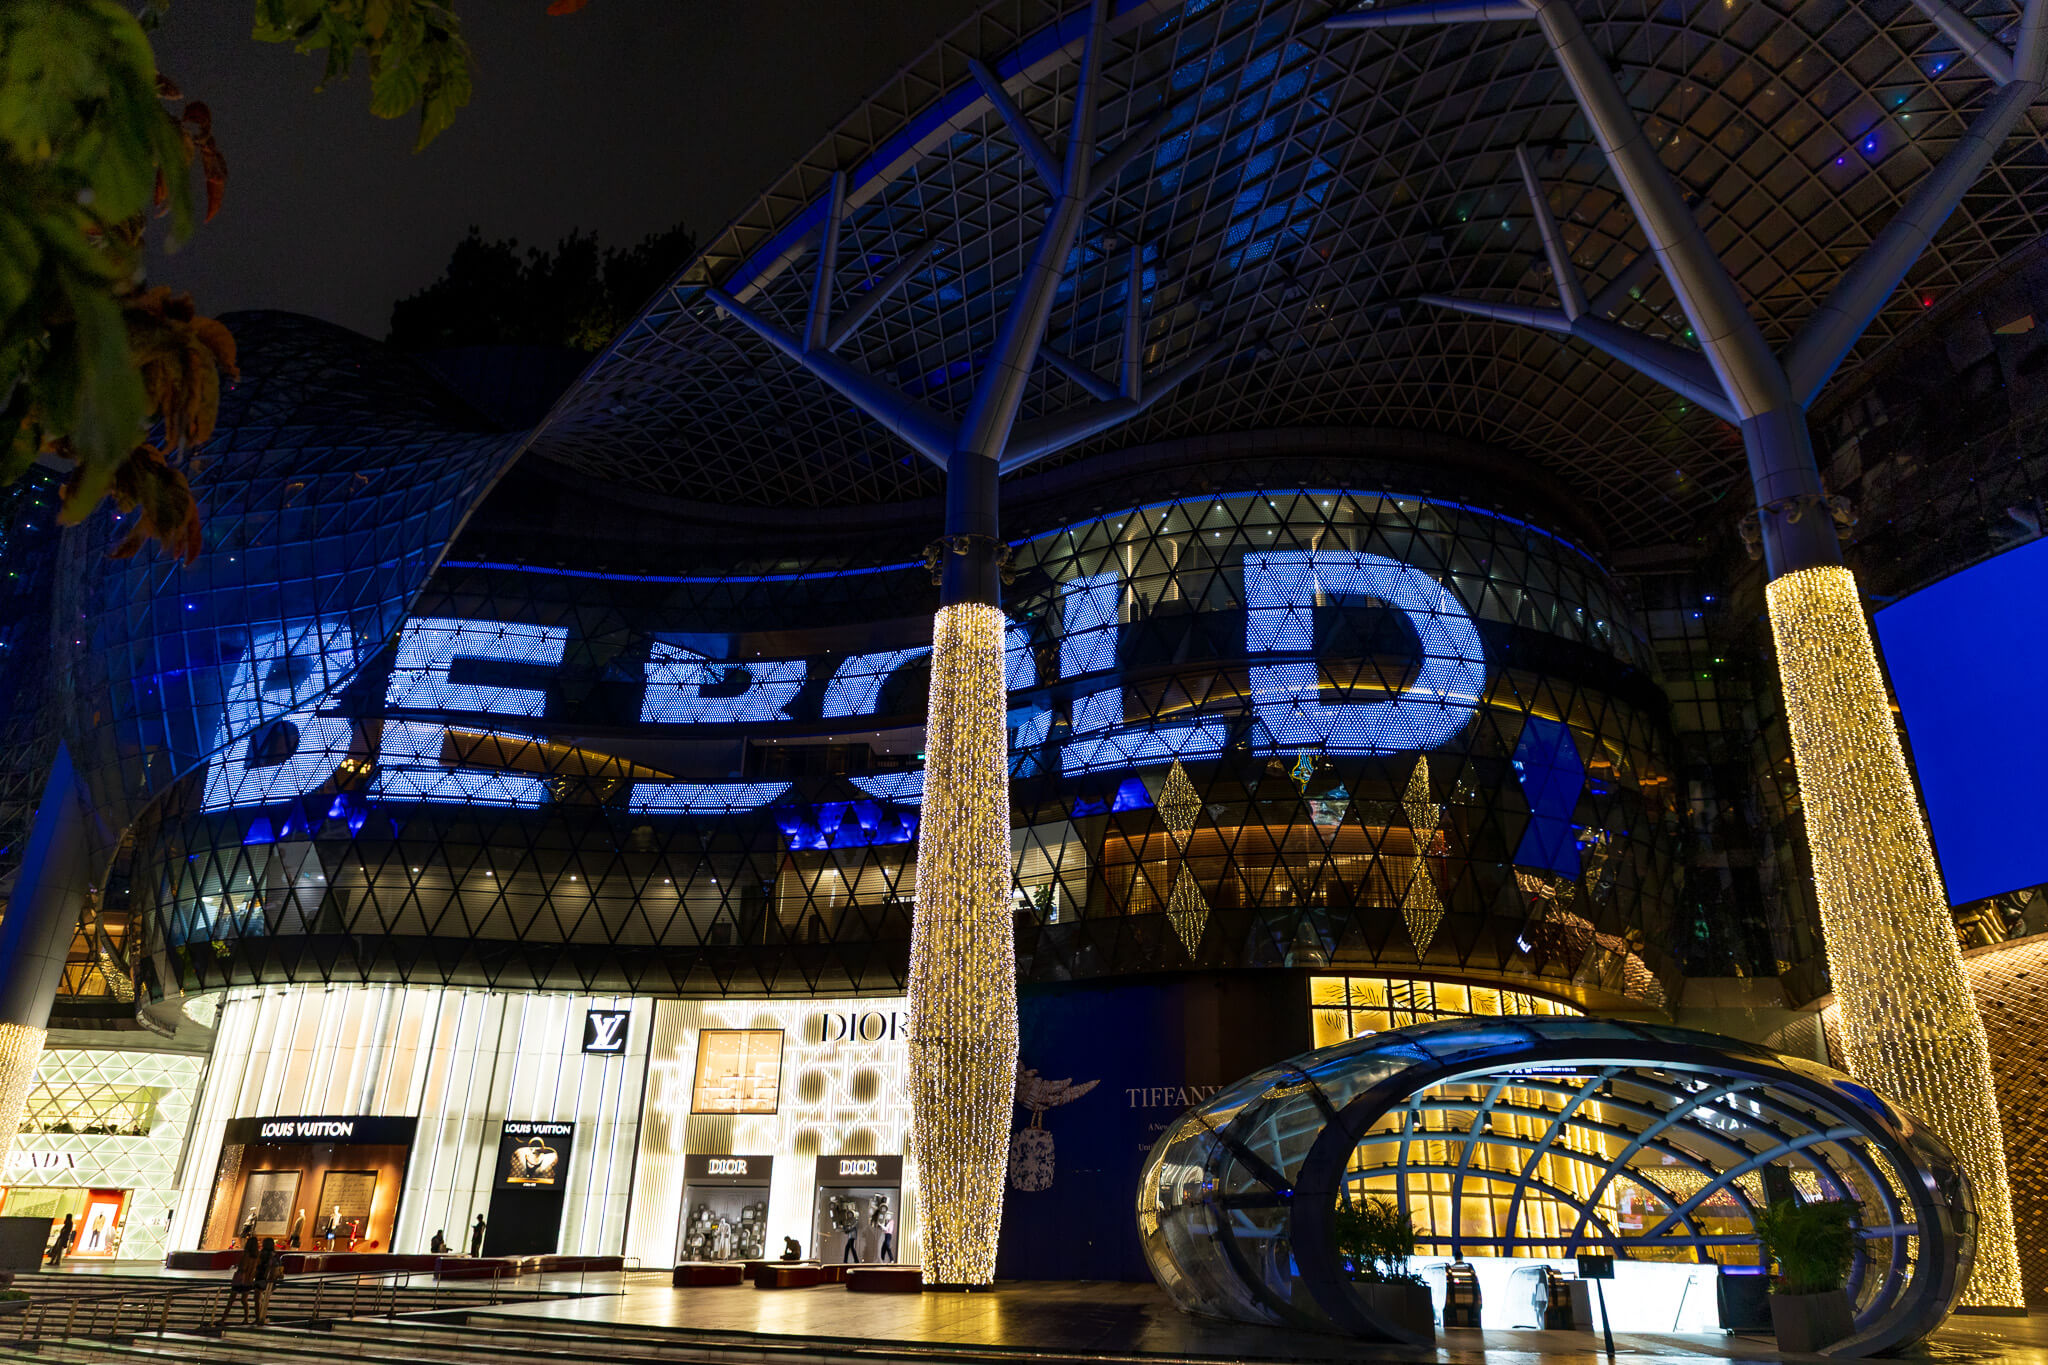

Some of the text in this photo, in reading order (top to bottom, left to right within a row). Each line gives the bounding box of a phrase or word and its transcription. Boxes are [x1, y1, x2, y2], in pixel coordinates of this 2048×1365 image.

[199, 615, 569, 815] BE
[821, 1011, 911, 1042] DIOR
[261, 1122, 353, 1137] LOUIS VUITTON
[505, 1123, 571, 1135] LOUIS VUITTON
[9, 1152, 75, 1168] RADA
[708, 1159, 748, 1175] DIOR
[839, 1160, 877, 1175] DIOR
